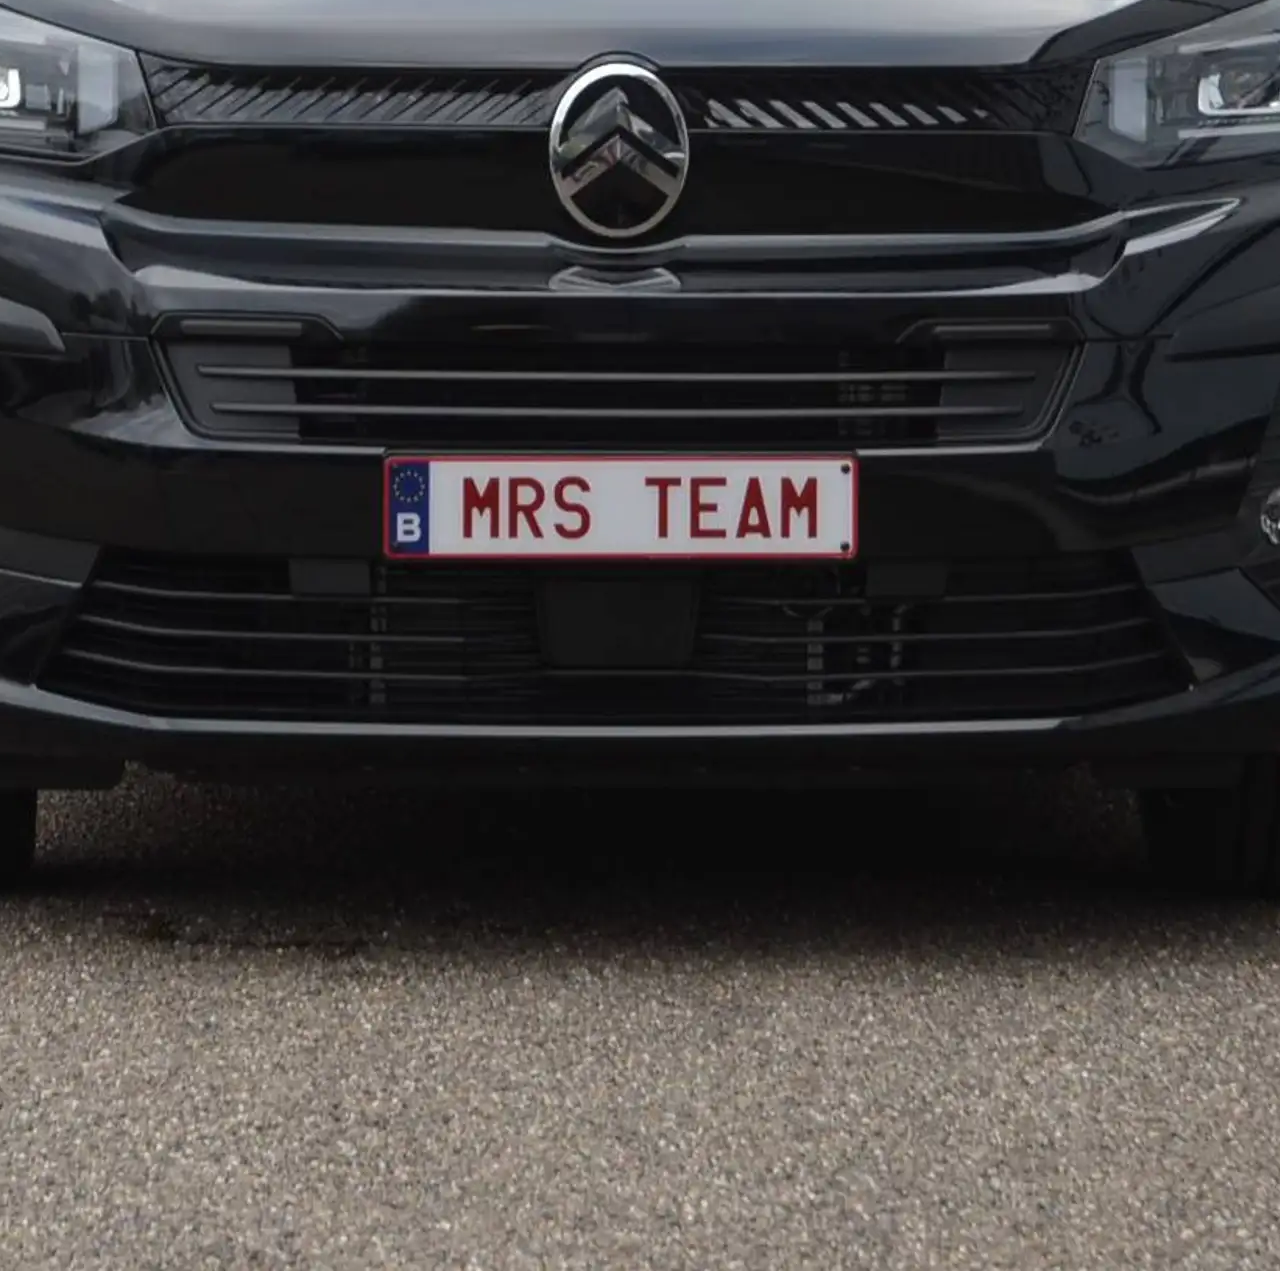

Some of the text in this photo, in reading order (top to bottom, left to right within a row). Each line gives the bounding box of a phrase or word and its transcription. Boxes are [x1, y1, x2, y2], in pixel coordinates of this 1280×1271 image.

[396, 512, 421, 542] B
[462, 476, 819, 540] MRS TEAM
